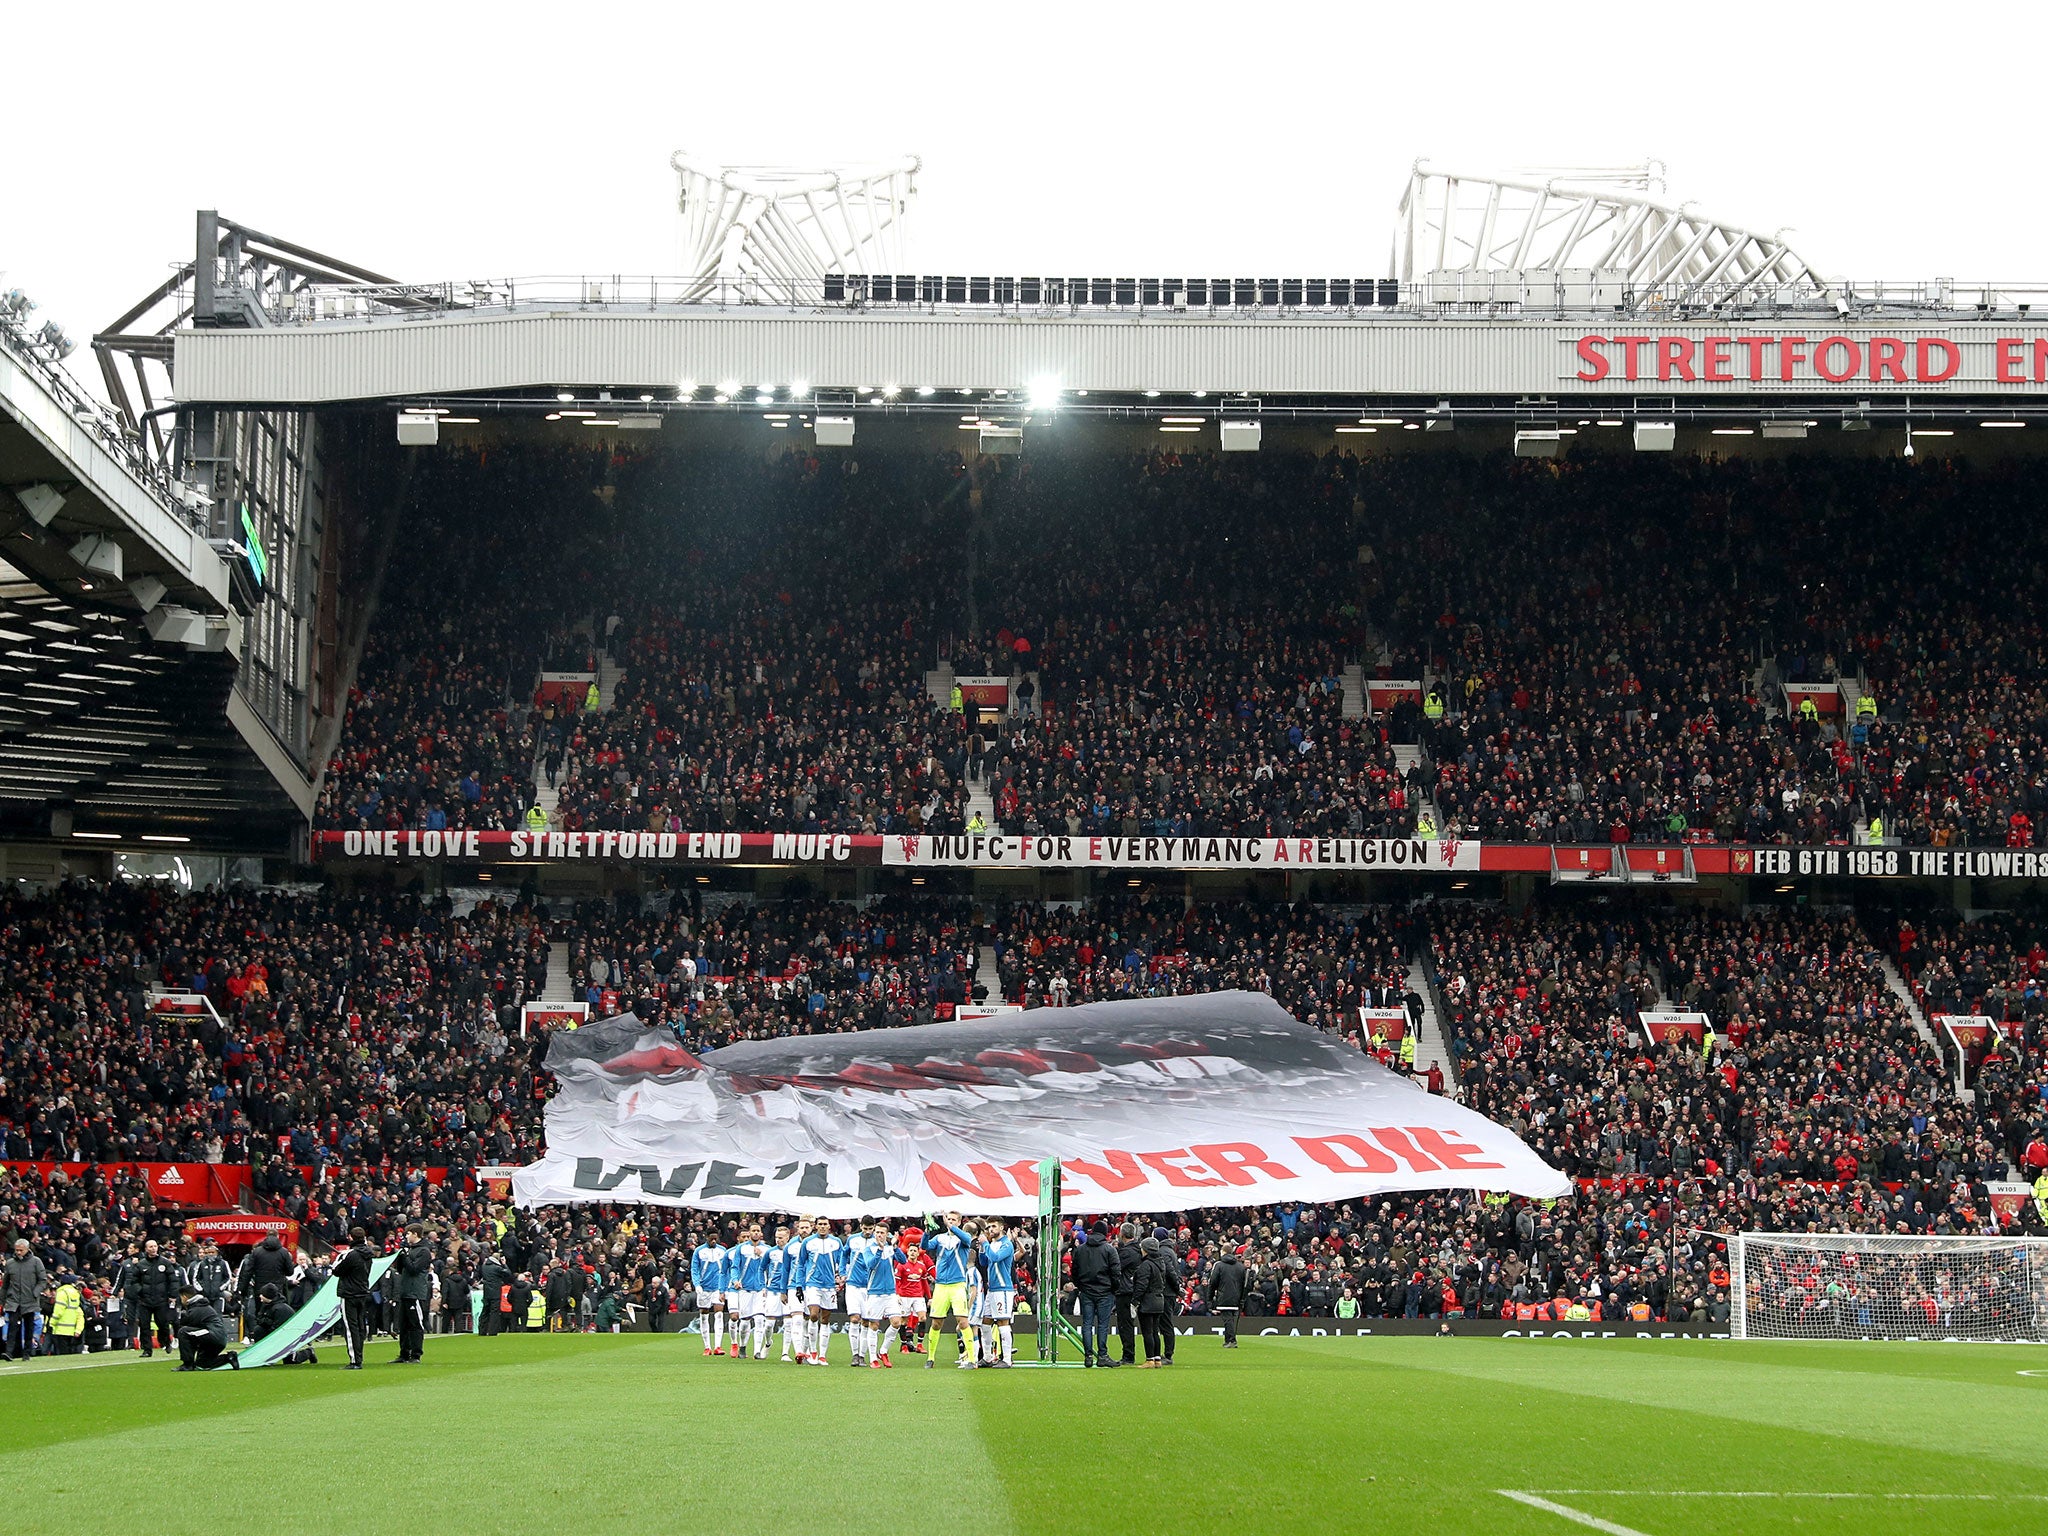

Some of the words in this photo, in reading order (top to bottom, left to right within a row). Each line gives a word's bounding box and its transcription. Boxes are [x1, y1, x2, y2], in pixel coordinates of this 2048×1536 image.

[1577, 334, 1962, 383] STRETFORD
[343, 830, 399, 857] ONE
[407, 830, 480, 857] LOVE
[509, 830, 678, 859] STRETFORD
[688, 832, 742, 860] END
[771, 833, 852, 861] MUFC
[931, 836, 1073, 861] MUFC-FOR
[1298, 838, 1428, 864] RELIGION
[1753, 850, 1791, 875] FEB
[1798, 850, 1839, 875] 6TH
[1846, 850, 1899, 876] 1958
[1909, 851, 1949, 877] THE
[1953, 851, 2048, 878] FLOWERS
[573, 1156, 911, 1203] WE'LL
[923, 1142, 1300, 1199] NEVER
[1290, 1126, 1506, 1174] DIE
[158, 1177, 184, 1185] adidas
[196, 1221, 254, 1230] MANCHESTER
[255, 1222, 287, 1230] UNITED
[996, 1301, 1003, 1312] 2
